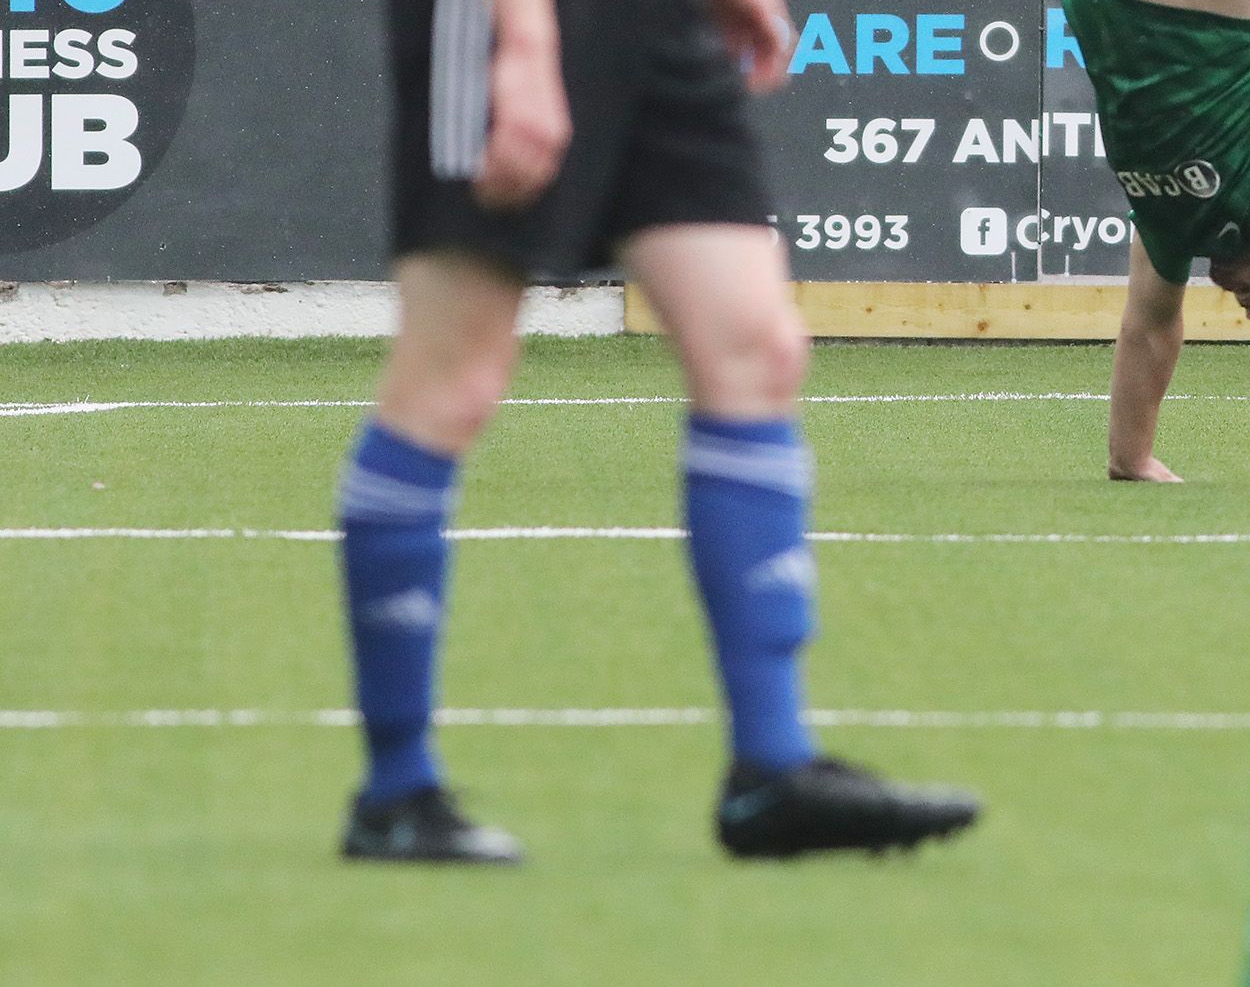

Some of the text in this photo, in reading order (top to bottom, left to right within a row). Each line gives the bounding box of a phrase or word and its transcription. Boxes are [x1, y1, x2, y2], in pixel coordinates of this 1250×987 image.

[0, 28, 138, 79] ESS
[787, 13, 965, 74] ARE
[823, 118, 936, 163] 367
[795, 214, 909, 250] 3993
